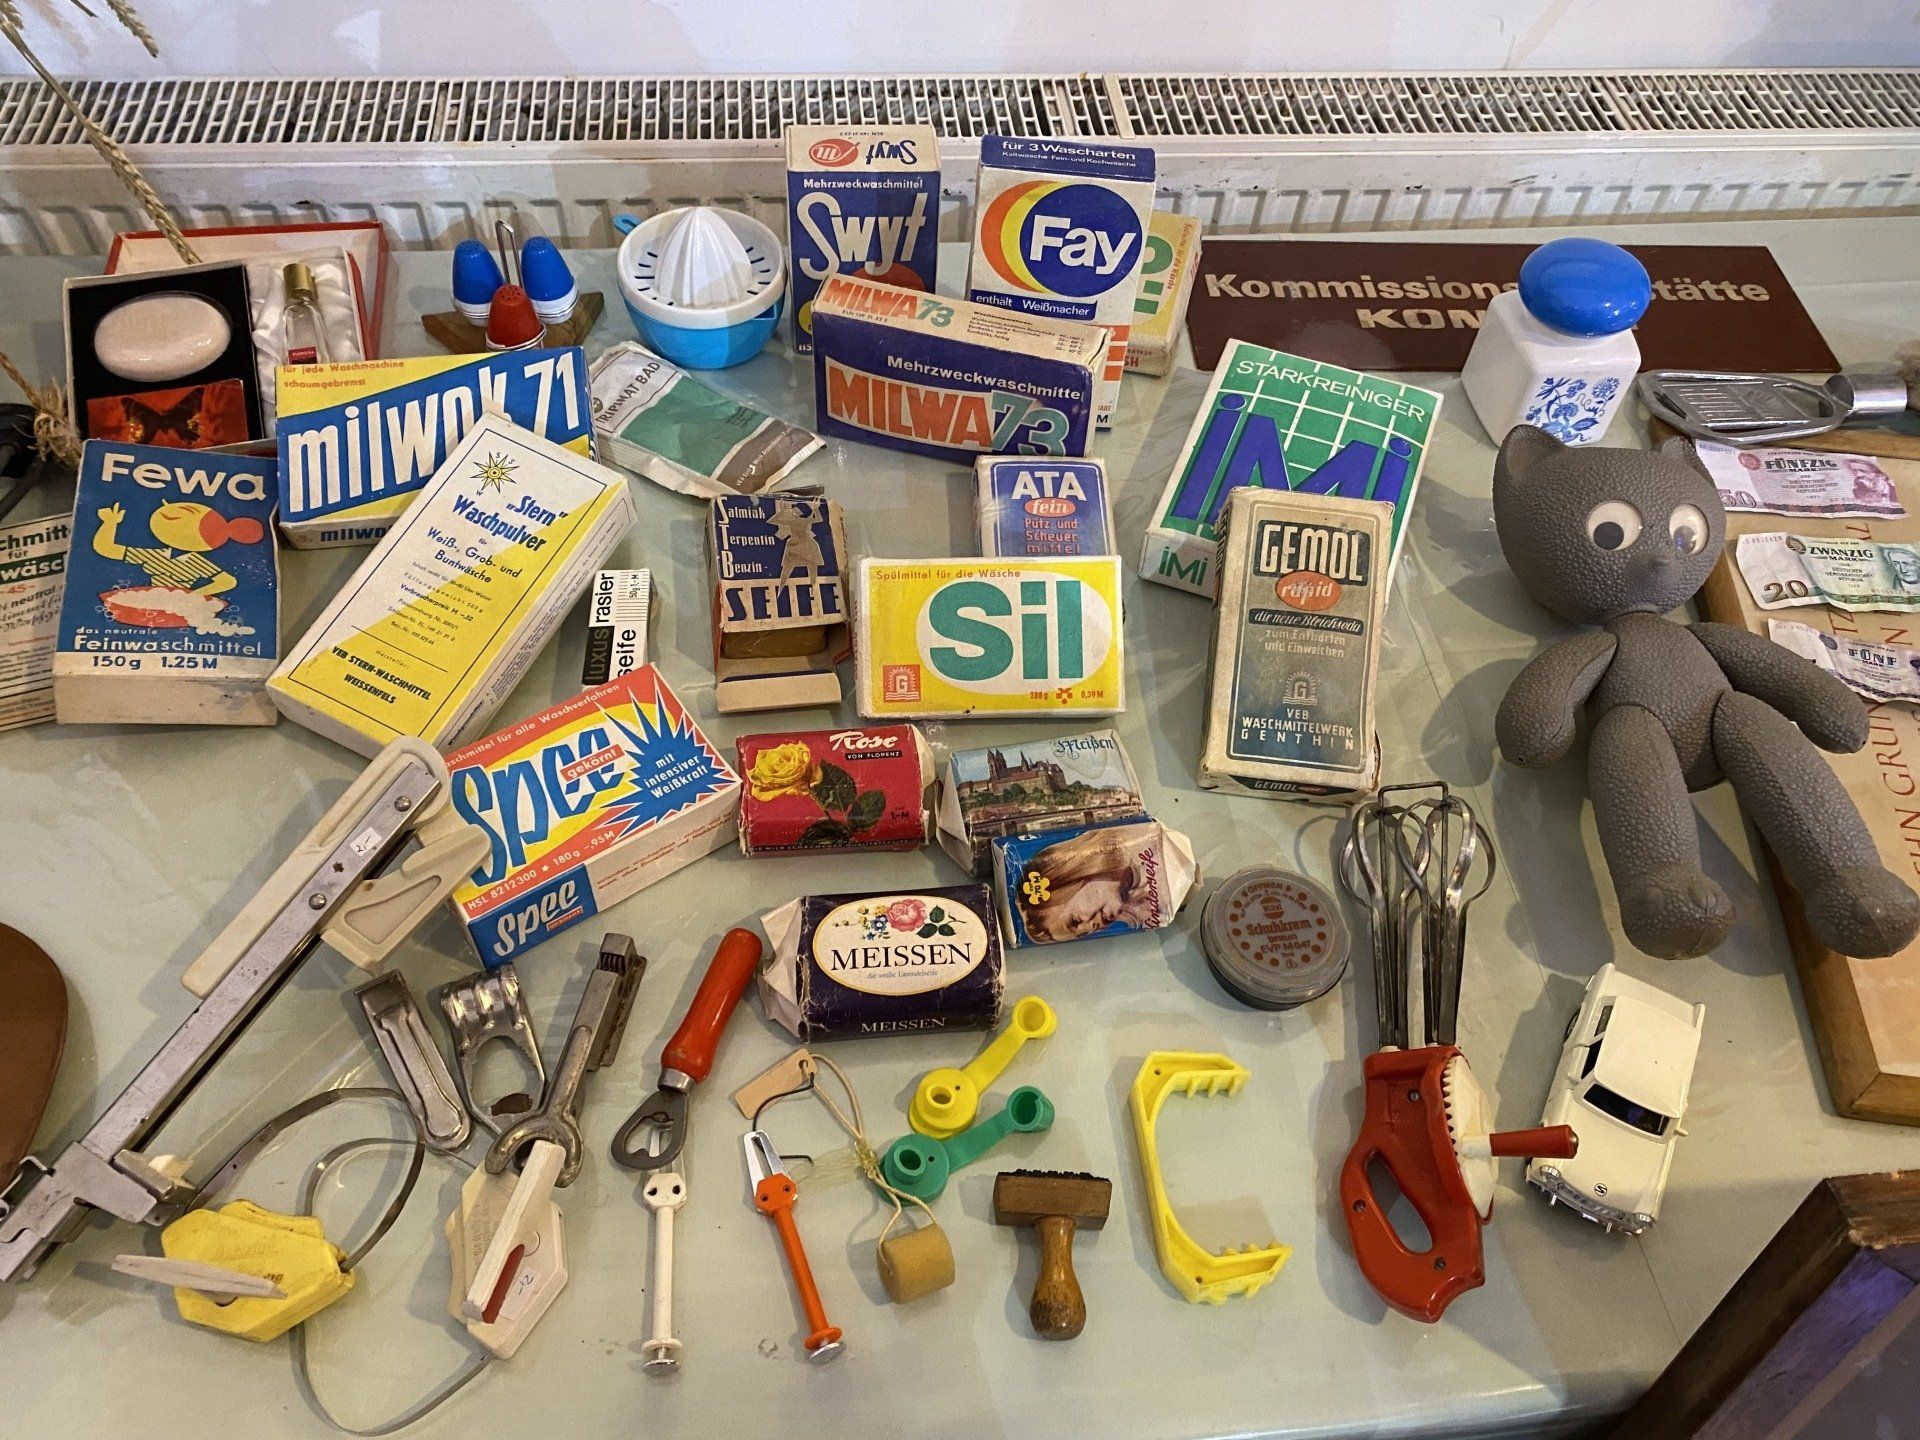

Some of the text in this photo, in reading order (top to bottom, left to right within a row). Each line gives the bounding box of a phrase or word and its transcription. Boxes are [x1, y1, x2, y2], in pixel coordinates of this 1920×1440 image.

[866, 140, 918, 165] Swyt
[1002, 141, 1136, 160] für 3 Wascharten
[803, 178, 923, 189] Mehrzweckwaschmittel
[796, 191, 929, 280] Swyt
[1029, 215, 1137, 275] Fay
[821, 278, 955, 328] MILWA 73
[976, 294, 1090, 316] enthält Weißmacher
[302, 366, 324, 375] jede
[330, 361, 405, 372] Waschmaschine
[634, 360, 661, 386] BAD
[886, 355, 1085, 403] Mehrzweckwaschmittel
[523, 351, 581, 436] 71
[1236, 360, 1426, 423] STARKREINIGER
[828, 366, 1070, 457] MILWA 73
[101, 452, 267, 501] Fewa
[1763, 457, 1838, 470] FÜNFZIG
[1011, 471, 1087, 502] ATA
[714, 496, 766, 524] Salmiak
[1031, 498, 1069, 515] fein
[452, 494, 547, 552] Waschpulver
[1024, 517, 1079, 530] Putz- und
[718, 524, 775, 551] Terpentin
[1026, 544, 1081, 555] mittel
[8, 550, 29, 560] für
[465, 546, 497, 568] Grob-
[500, 564, 524, 579] und
[1259, 524, 1364, 582] GEMOL
[1808, 546, 1874, 559] ZWANZIG
[434, 549, 492, 584] Buntwäsche
[876, 568, 1021, 581] Spülmittel für die Wäsche
[400, 583, 450, 611] Verbraucherpreis
[595, 572, 615, 624] rasier
[725, 582, 841, 621] SEIFE
[1280, 579, 1333, 606] rapid
[1763, 579, 1809, 603] 20
[76, 626, 159, 636] das neutrale
[929, 580, 1084, 681] Sil
[1254, 611, 1361, 633] die neue Bleichsoda
[1265, 630, 1289, 640] zum
[74, 635, 262, 656] Feinwaschmittel
[585, 628, 610, 680] luxus
[616, 628, 637, 678] seife
[1264, 640, 1345, 659] und Einweichen
[1847, 648, 1898, 666] FÜNF
[92, 656, 218, 671] 150 g 1.25 M
[331, 645, 432, 701] VEB STERN-WASCHMITTEL
[344, 673, 397, 704] WEISSENFELS
[497, 733, 513, 745] für
[514, 722, 537, 736] alle
[538, 684, 620, 724] Waschverfahren
[1286, 708, 1310, 720] VEB
[1241, 728, 1354, 751] GENTHIN
[1242, 716, 1354, 739] WASCHMITTELWERK
[829, 731, 898, 752] Rose
[1054, 735, 1114, 757] Meißen
[566, 749, 617, 779] gekörnt
[655, 753, 675, 769] mit
[847, 751, 900, 760] VON FLORENZ
[643, 755, 700, 788] intensiver
[650, 764, 709, 799] Weißkraft
[1254, 780, 1298, 792] GEMOL
[451, 727, 625, 888] Spee
[467, 896, 489, 911] HSL
[493, 880, 580, 957] Spee
[830, 943, 972, 971] MEISSEN
[861, 1017, 946, 1033] MEISSEN
